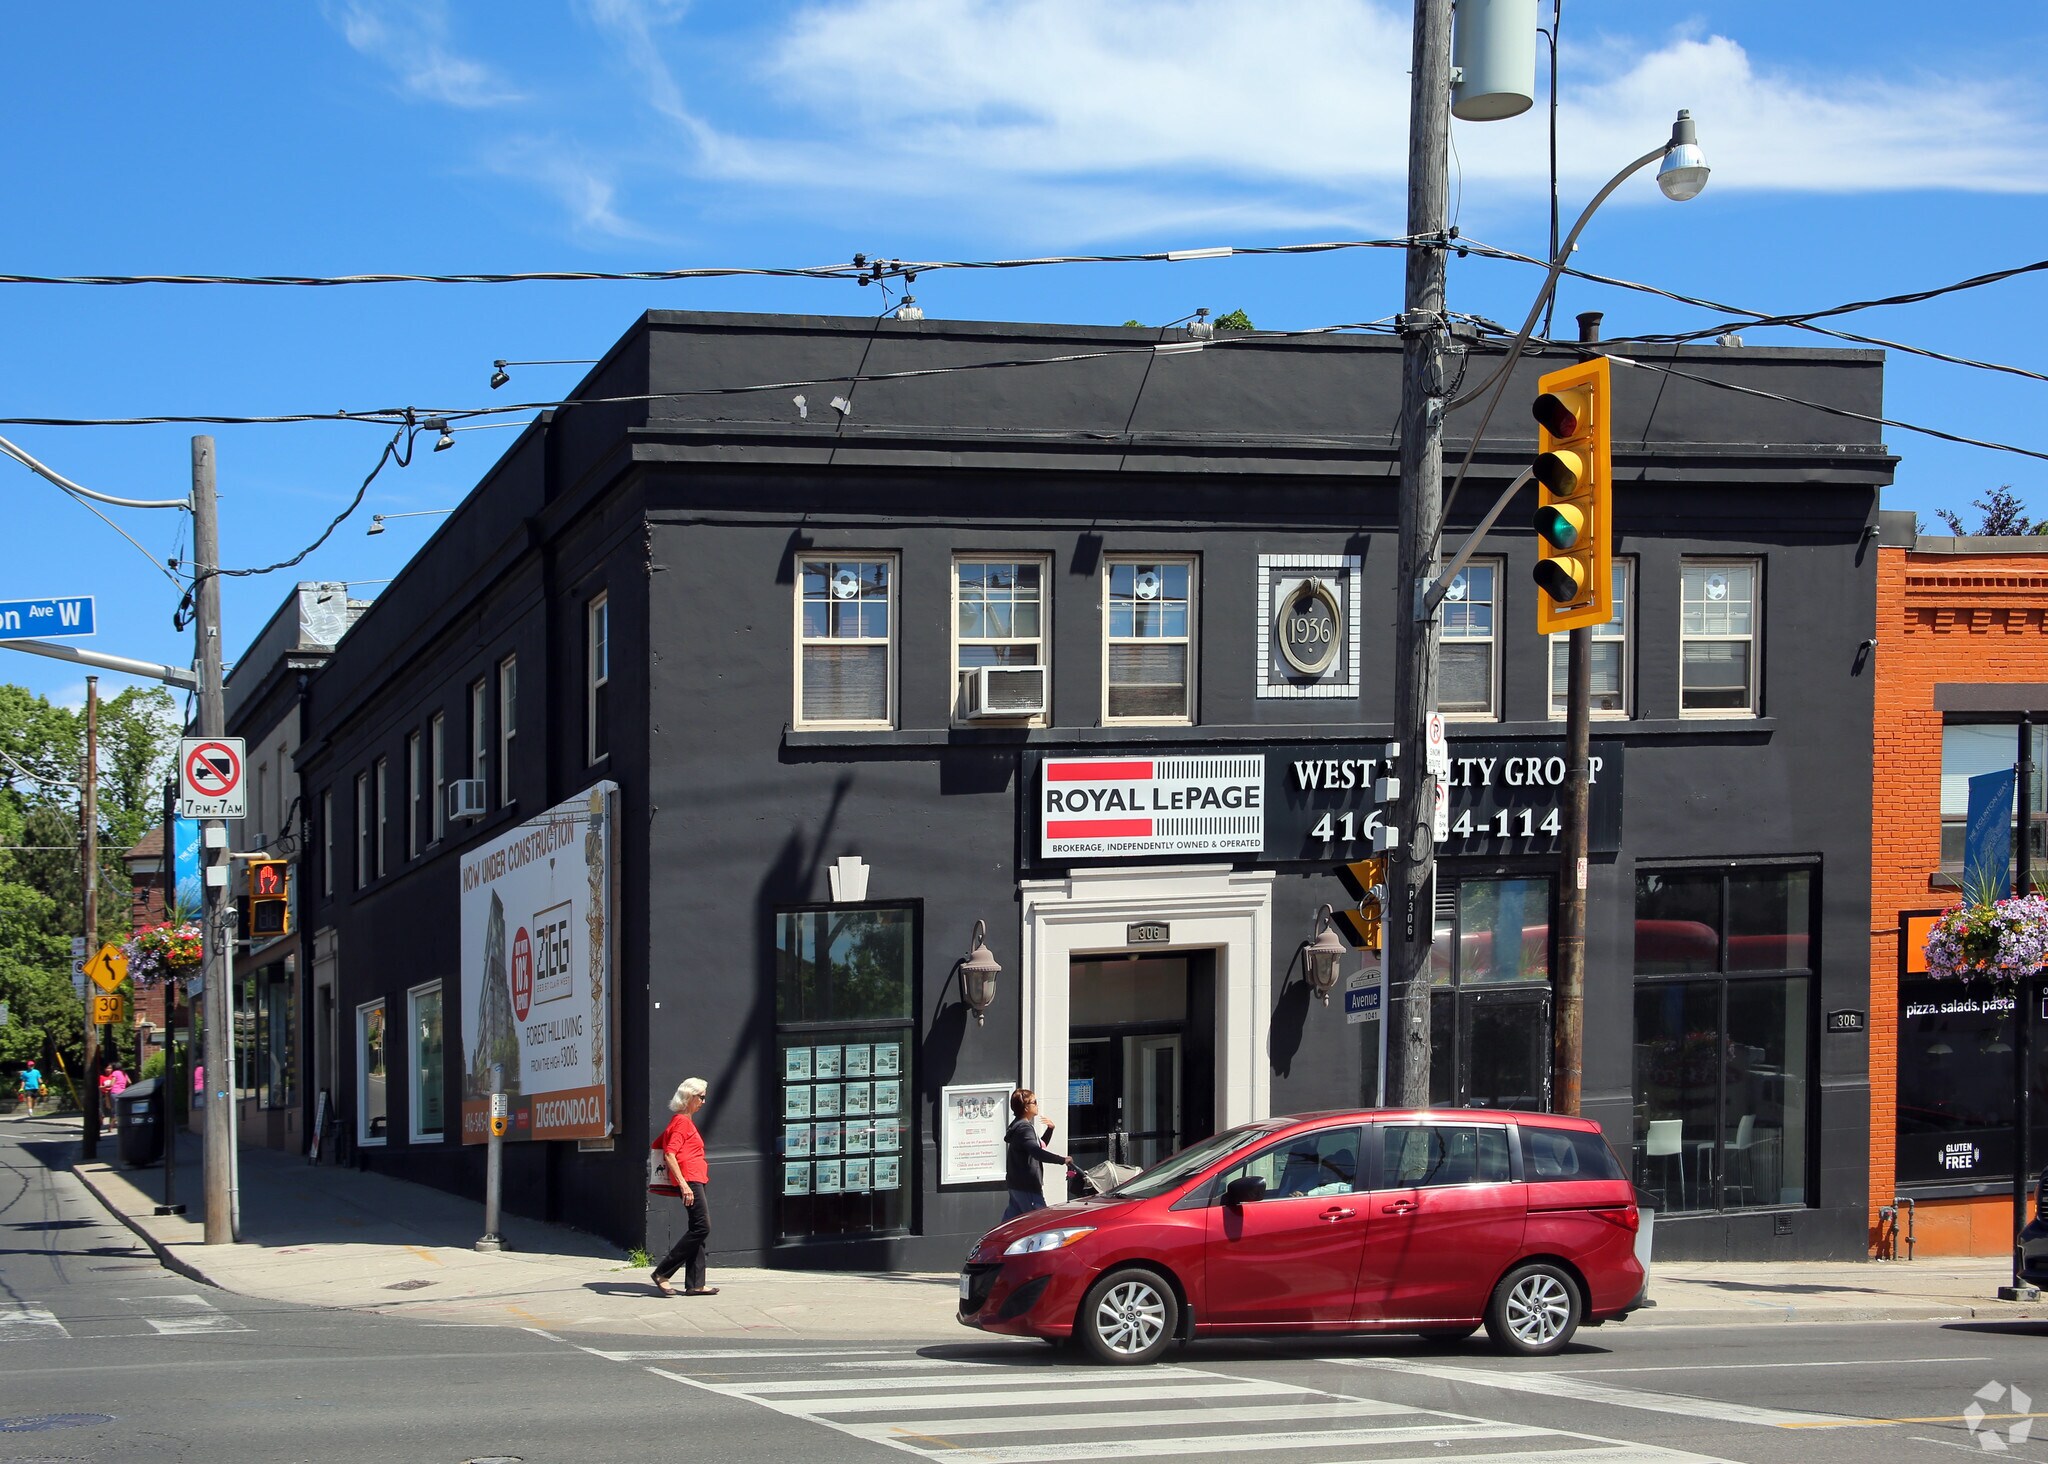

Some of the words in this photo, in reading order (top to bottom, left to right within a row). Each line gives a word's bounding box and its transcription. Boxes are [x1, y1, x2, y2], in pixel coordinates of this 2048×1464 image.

[29, 605, 54, 617] Ave
[58, 602, 81, 627] W
[1290, 618, 1331, 644] 1936
[1294, 759, 1377, 790] WEST
[1505, 756, 1603, 786] GROP
[1046, 788, 1145, 813] ROYAL
[463, 862, 480, 893] NOW
[482, 849, 507, 884] UNDER
[508, 813, 574, 872] CONSTRUCTION
[1052, 843, 1105, 853] BROKERAGE,
[1107, 841, 1174, 851] INDEPENDENTLY
[1176, 840, 1209, 849] OWNED
[1211, 839, 1217, 848] &
[1219, 839, 1261, 848] OPERATED
[1138, 926, 1160, 940] 306
[100, 998, 119, 1012] 30
[1352, 993, 1378, 1009] Avenue
[1906, 1001, 1938, 1018] pizza.
[1940, 998, 1980, 1013] salads.
[1982, 998, 2015, 1013] pasta
[1837, 1013, 1856, 1027] 306
[526, 1022, 547, 1047] FOREST
[548, 1020, 561, 1042] HILL
[562, 1014, 583, 1040] LIVING
[535, 1096, 601, 1128] ZIGGCONDO.CA
[1946, 1143, 1972, 1153] GLUTEN
[1946, 1155, 1972, 1169] FREE
